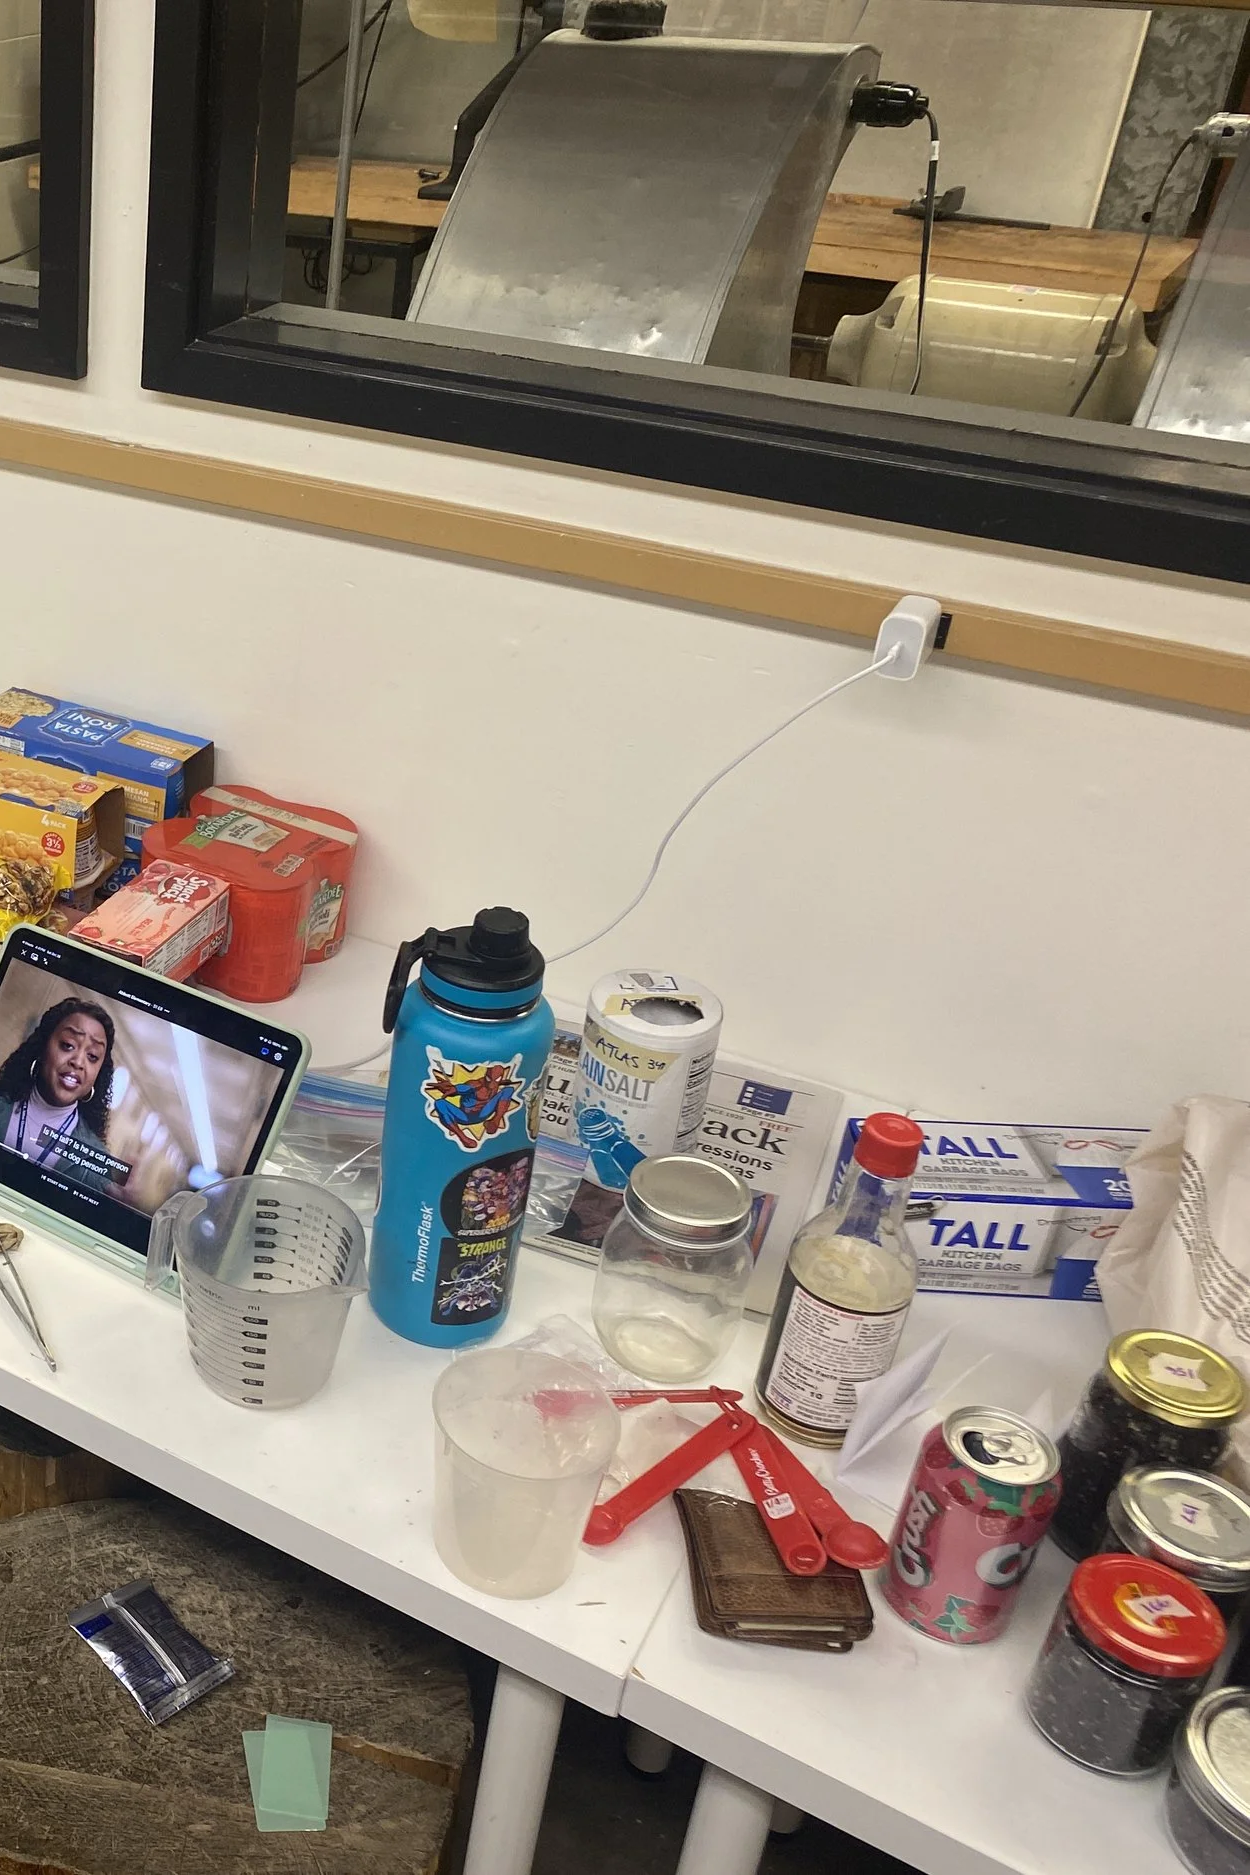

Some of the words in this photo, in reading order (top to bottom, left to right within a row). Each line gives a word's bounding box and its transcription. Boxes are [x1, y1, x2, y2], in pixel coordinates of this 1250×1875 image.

[67, 712, 118, 731] RONI
[53, 723, 102, 742] PASTA
[124, 786, 150, 797] MESAN
[174, 876, 209, 904] Snack
[596, 1037, 639, 1068] ATLAS
[705, 1106, 724, 1115] INCE
[759, 1121, 793, 1133] FREE
[49, 1130, 58, 1140] he
[59, 1134, 73, 1146] tall?
[79, 1144, 89, 1154] he
[95, 1152, 106, 1162] cat
[105, 1157, 129, 1173] person
[696, 1141, 773, 1171] ressions
[68, 1152, 80, 1165] dog
[80, 1159, 108, 1175] person?
[922, 1165, 991, 1176] GARBAGE
[993, 1167, 1029, 1178] BAGS
[940, 1157, 1002, 1168] KITCHEN
[929, 1218, 1031, 1251] TALL
[412, 1206, 433, 1283] ThermoFlask
[459, 1238, 507, 1257] STRANGE
[917, 1259, 987, 1270] GARBAGE
[989, 1261, 1023, 1272] BAGS
[941, 1251, 1003, 1261] KITCHEN
[893, 1485, 942, 1587] Crush
